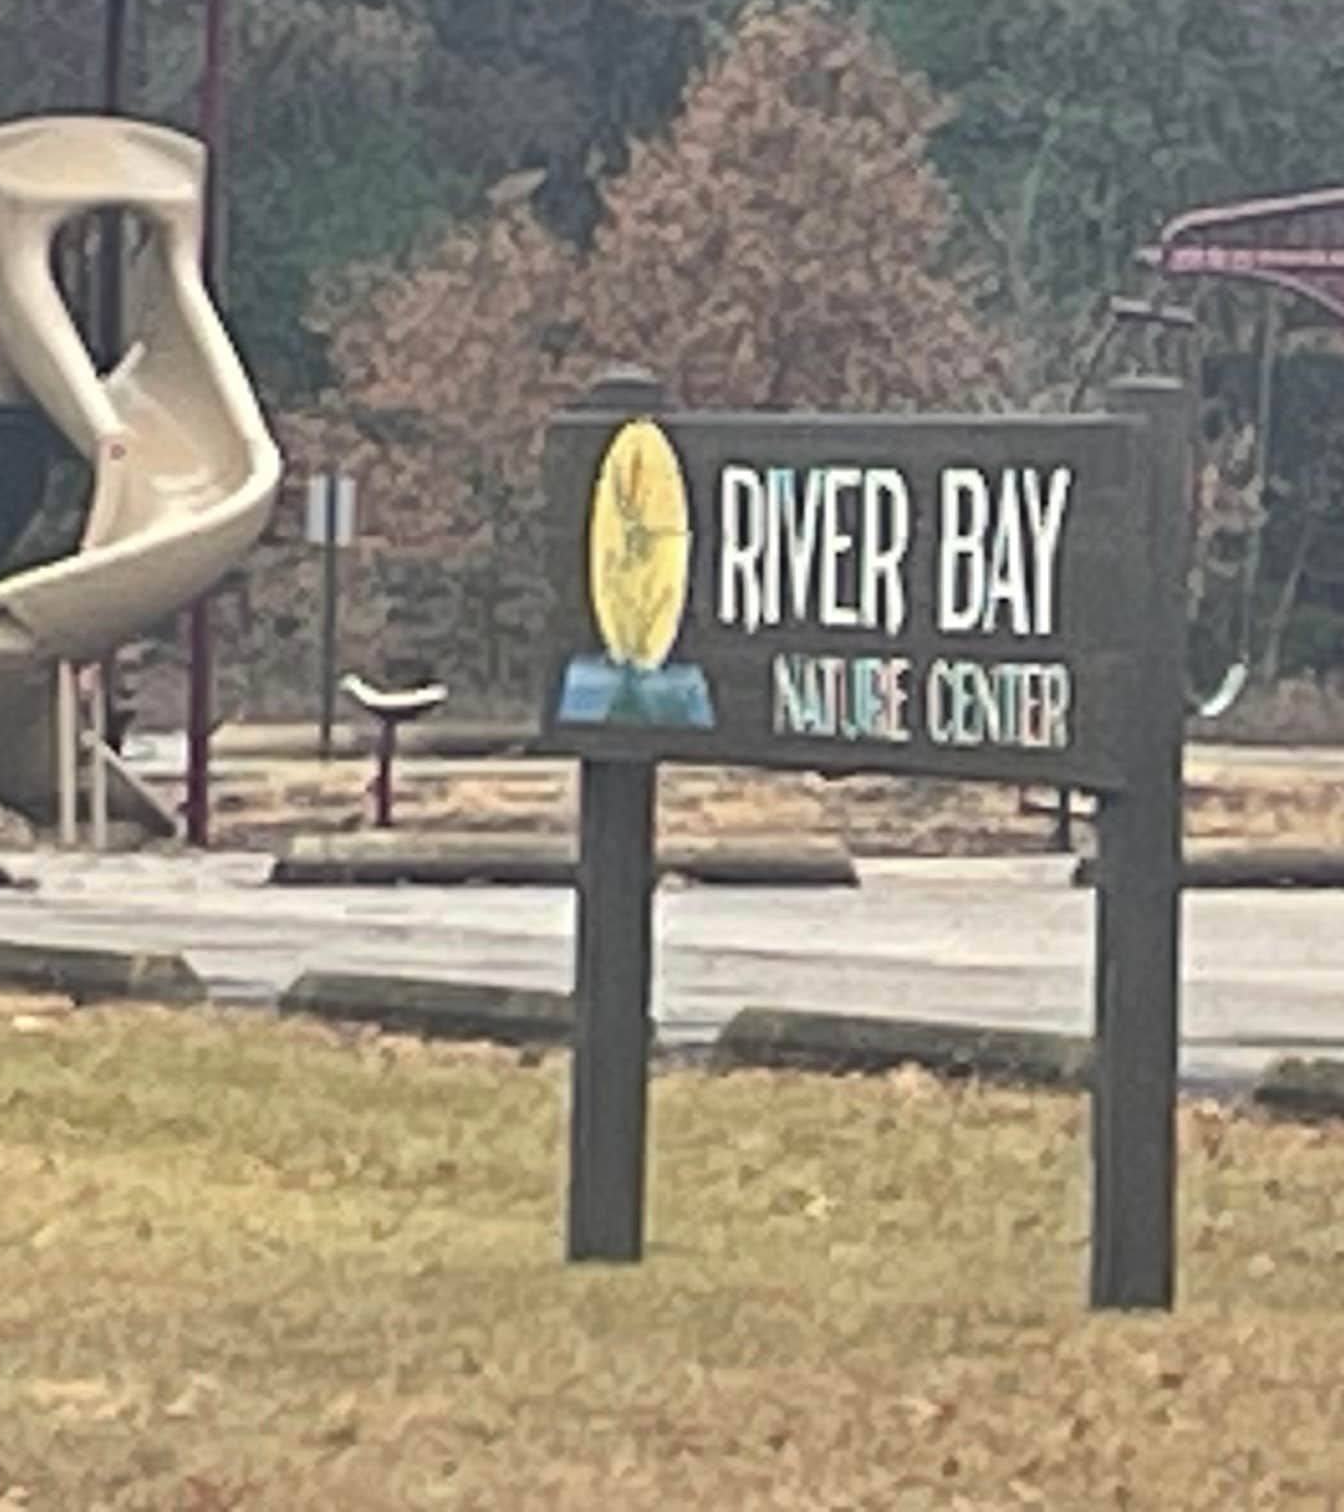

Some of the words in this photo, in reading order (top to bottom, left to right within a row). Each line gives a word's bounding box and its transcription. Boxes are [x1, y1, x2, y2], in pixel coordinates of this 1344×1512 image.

[718, 465, 909, 636] RIVER
[938, 467, 1071, 636] BAY
[773, 652, 912, 743] NATURE
[926, 657, 1072, 748] CENTER
